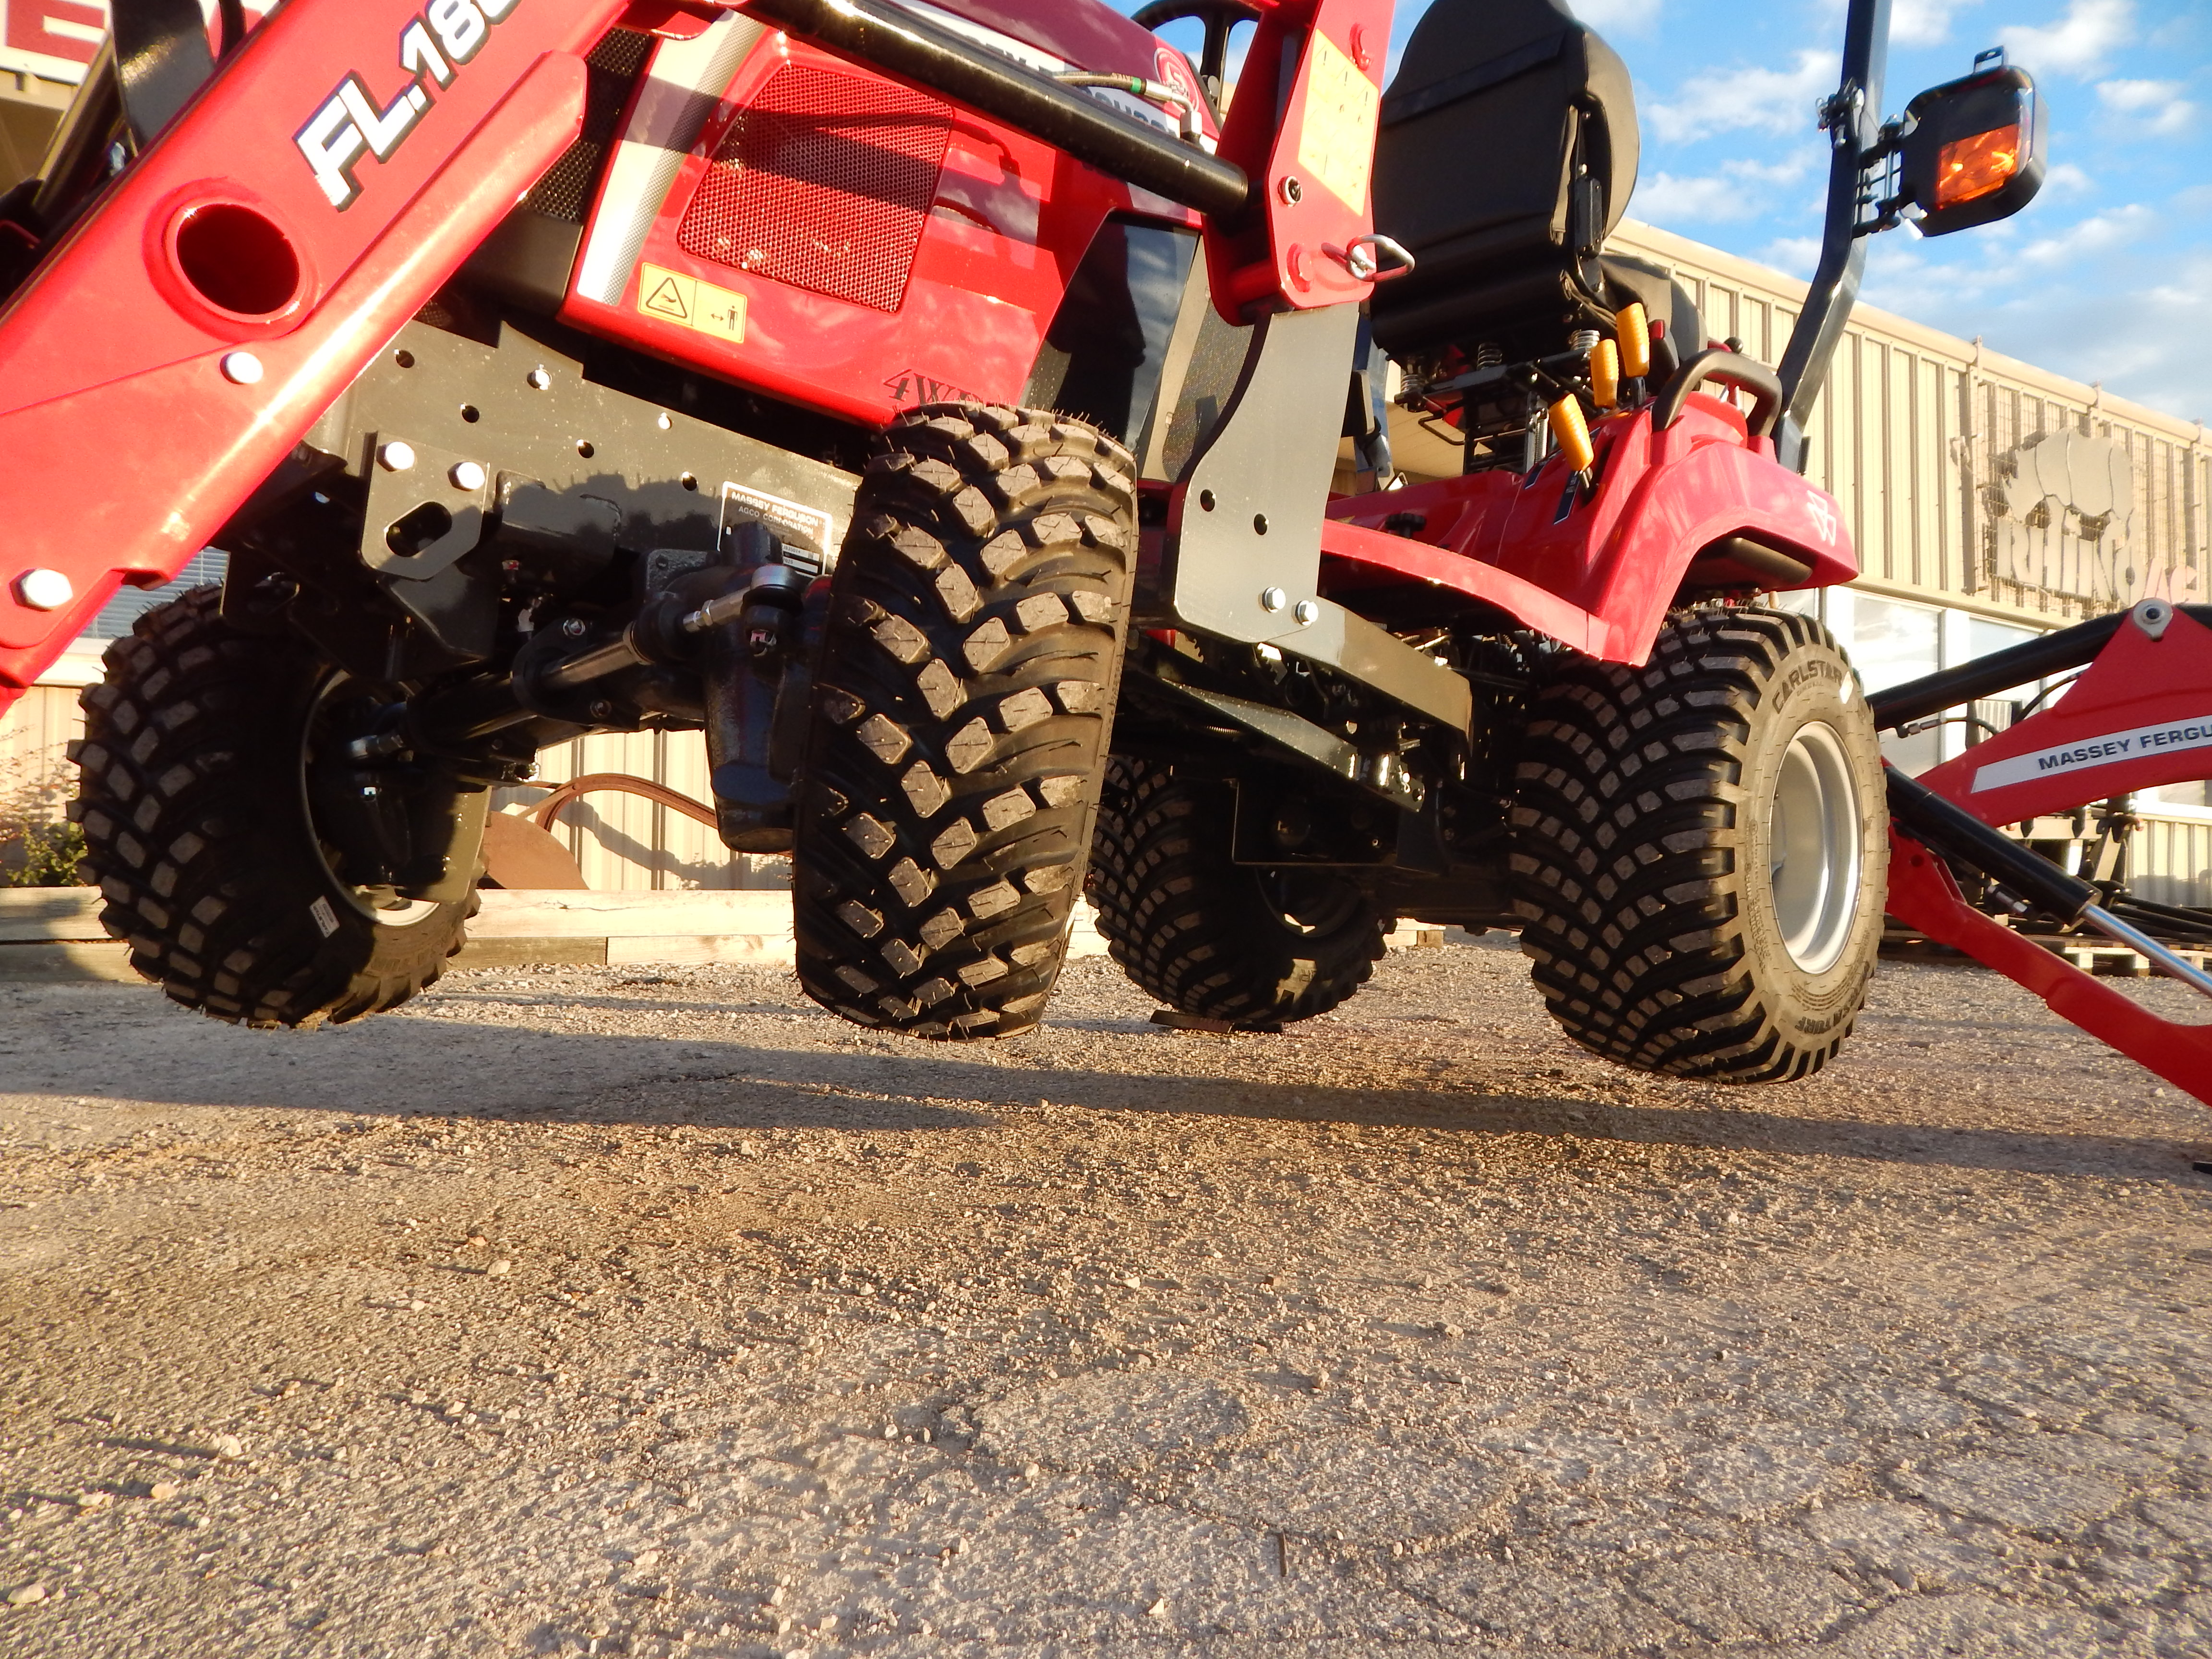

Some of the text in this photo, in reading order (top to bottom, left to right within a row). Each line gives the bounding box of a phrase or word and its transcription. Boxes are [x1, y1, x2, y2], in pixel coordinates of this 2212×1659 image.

[732, 491, 819, 527] MASSEY FERGUSON
[738, 505, 760, 517] AGCO
[763, 513, 814, 535] CORPORATION
[1772, 660, 1842, 714] CARLSTAR
[2038, 738, 2130, 770] MASSEY
[1794, 1016, 1831, 1034] TURF
